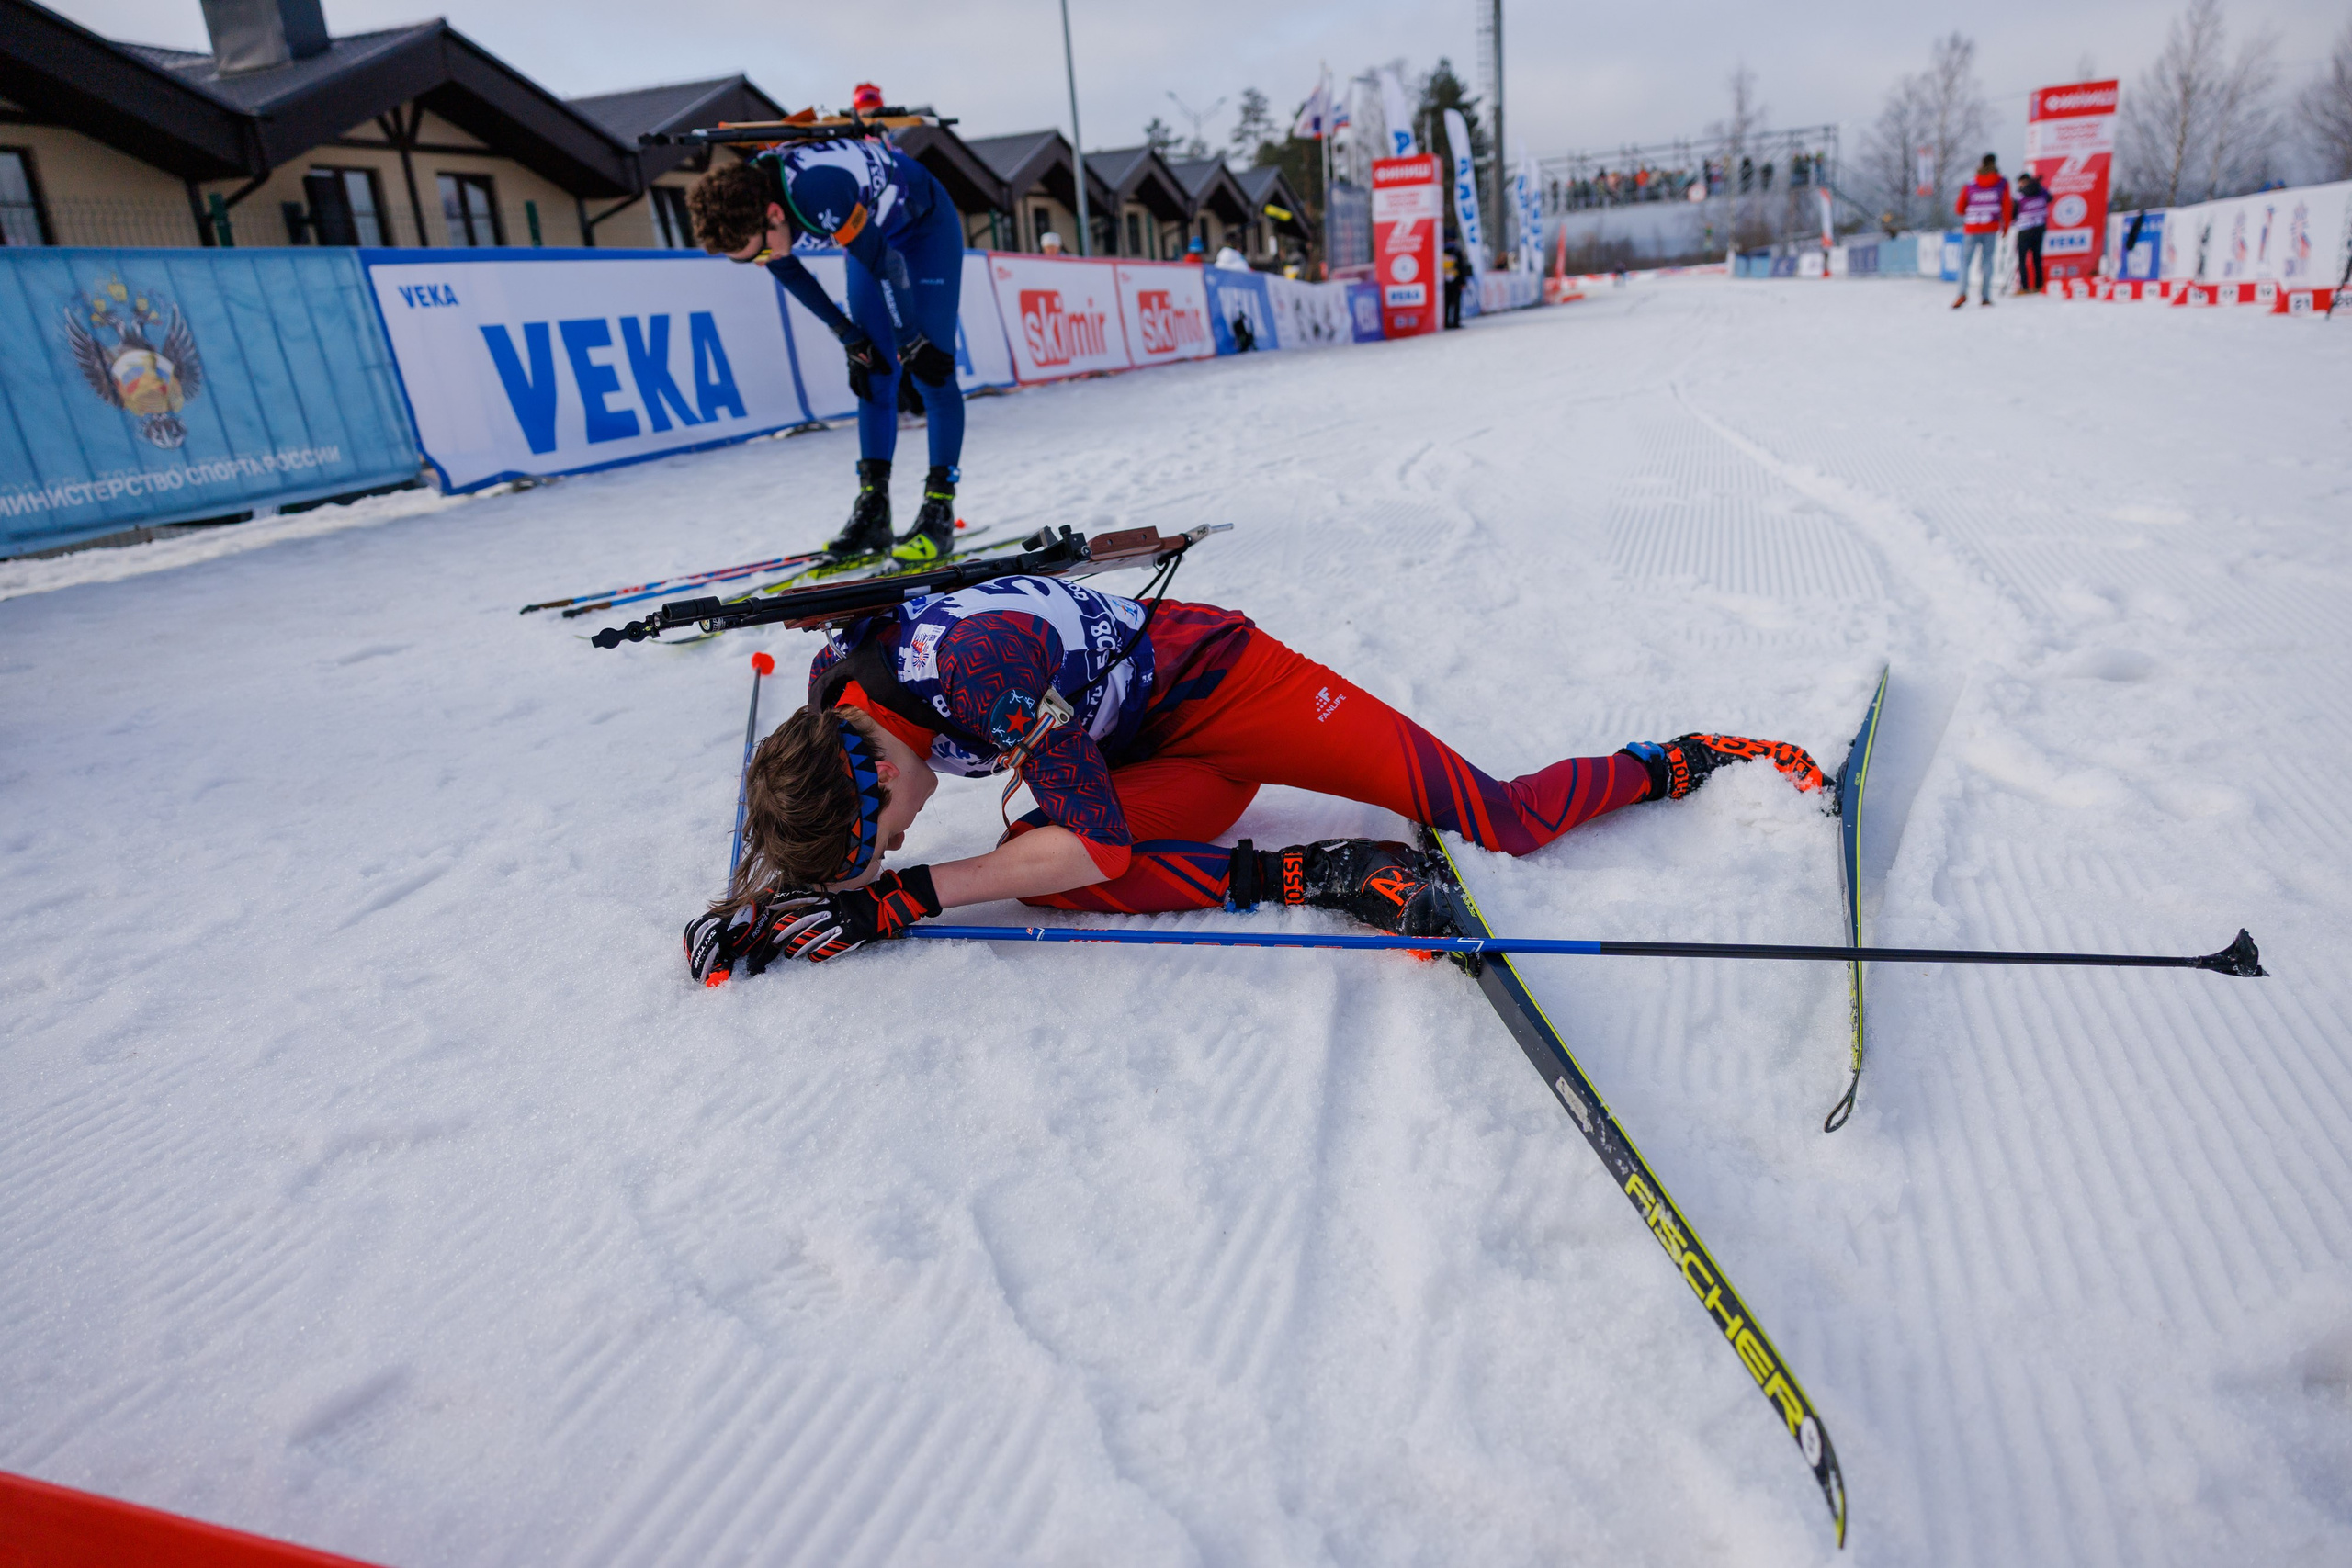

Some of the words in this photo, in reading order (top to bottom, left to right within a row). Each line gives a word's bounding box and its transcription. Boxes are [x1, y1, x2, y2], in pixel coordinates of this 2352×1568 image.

[397, 283, 459, 310] VEKA
[1020, 289, 1108, 368] skimir
[480, 310, 748, 455] VEKA
[186, 459, 266, 485] СПОРТА
[266, 446, 341, 474] РОССИИ
[1317, 694, 1347, 723] FANLIFE
[1283, 855, 1304, 907] OSSI
[1625, 1173, 1804, 1436] FISCHER
